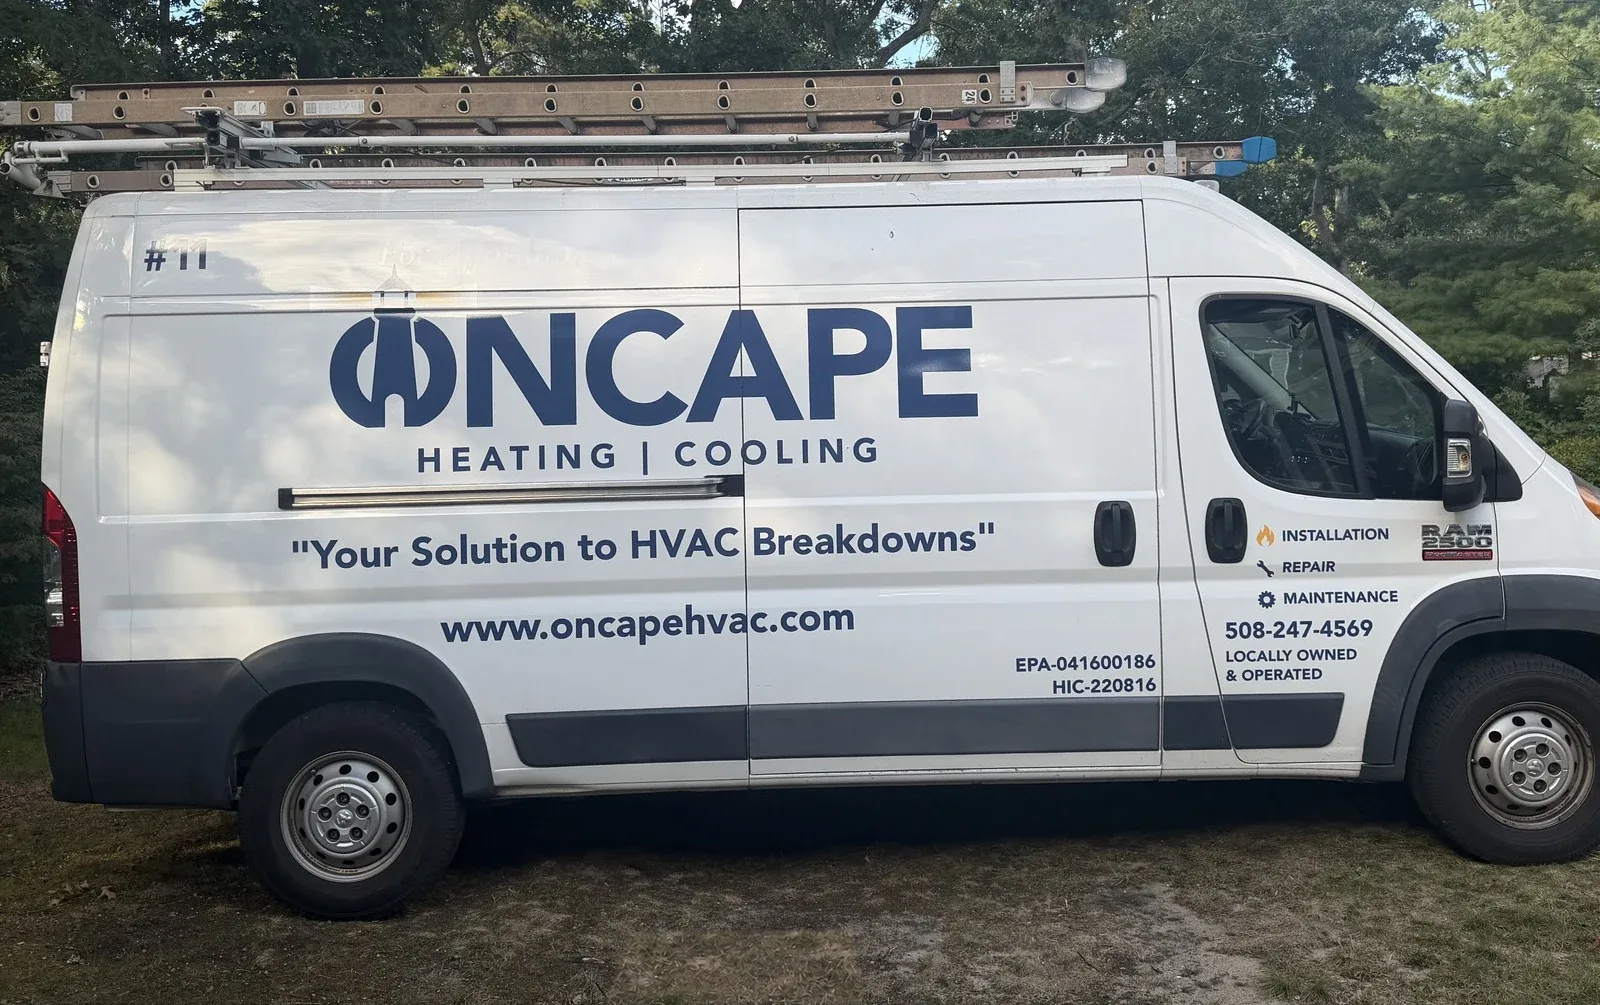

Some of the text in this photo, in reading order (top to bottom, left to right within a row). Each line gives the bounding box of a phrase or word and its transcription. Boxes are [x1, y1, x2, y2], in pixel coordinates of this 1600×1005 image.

[144, 239, 207, 272] #11
[329, 304, 979, 429] ONCAPE
[418, 443, 616, 474] HEATING
[674, 437, 878, 467] COOLING
[1282, 528, 1390, 543] INSTALLATION
[1421, 523, 1493, 537] RAM
[292, 521, 995, 569] "Your Solution to HVAC Breakdowns"
[1422, 536, 1493, 549] 2500
[1282, 561, 1336, 574] REPAIR
[1283, 590, 1399, 605] MAINTENANCE
[440, 604, 855, 646] www.oncapehvac.com
[1225, 618, 1374, 640] 508-247-4569
[1015, 654, 1156, 673] EPA-041600186
[1225, 648, 1358, 663] LOCALLY OWNED
[1225, 668, 1323, 682] & OPERATED
[1052, 677, 1157, 695] HIC-220816
